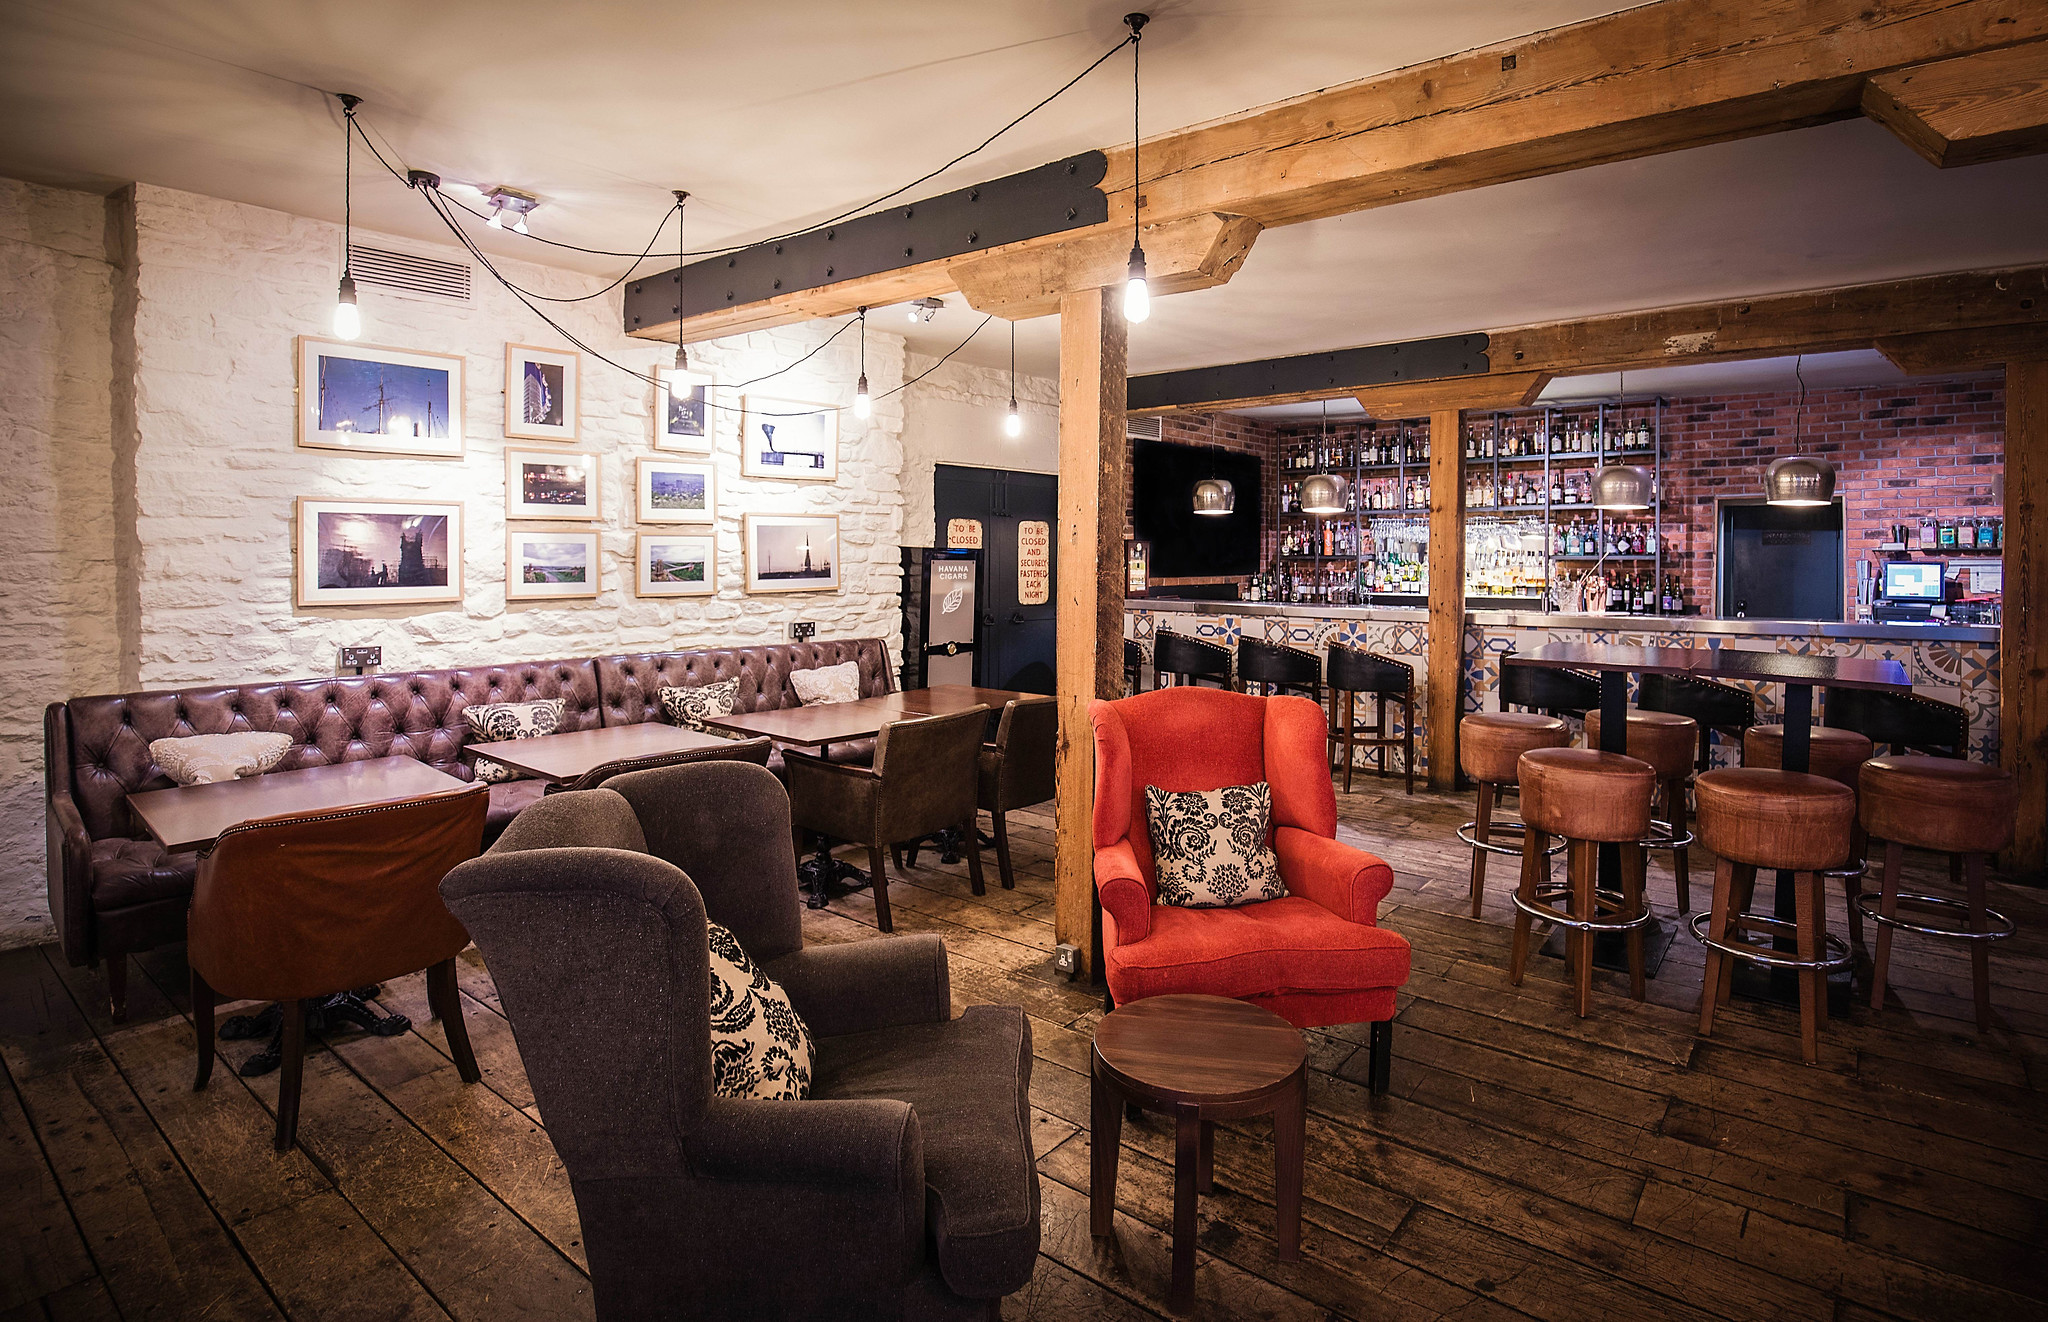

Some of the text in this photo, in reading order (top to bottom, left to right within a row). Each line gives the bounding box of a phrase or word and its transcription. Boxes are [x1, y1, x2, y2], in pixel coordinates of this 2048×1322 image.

[969, 525, 976, 533] BE
[1036, 527, 1044, 535] BE
[951, 536, 978, 544] CLOSED
[1021, 537, 1046, 545] CLOSED
[1026, 548, 1041, 556] AND
[1020, 559, 1047, 567] SECURELY
[1020, 570, 1047, 578] FASTENED
[1026, 580, 1041, 589] EACH
[1024, 591, 1043, 599] NIGHT
